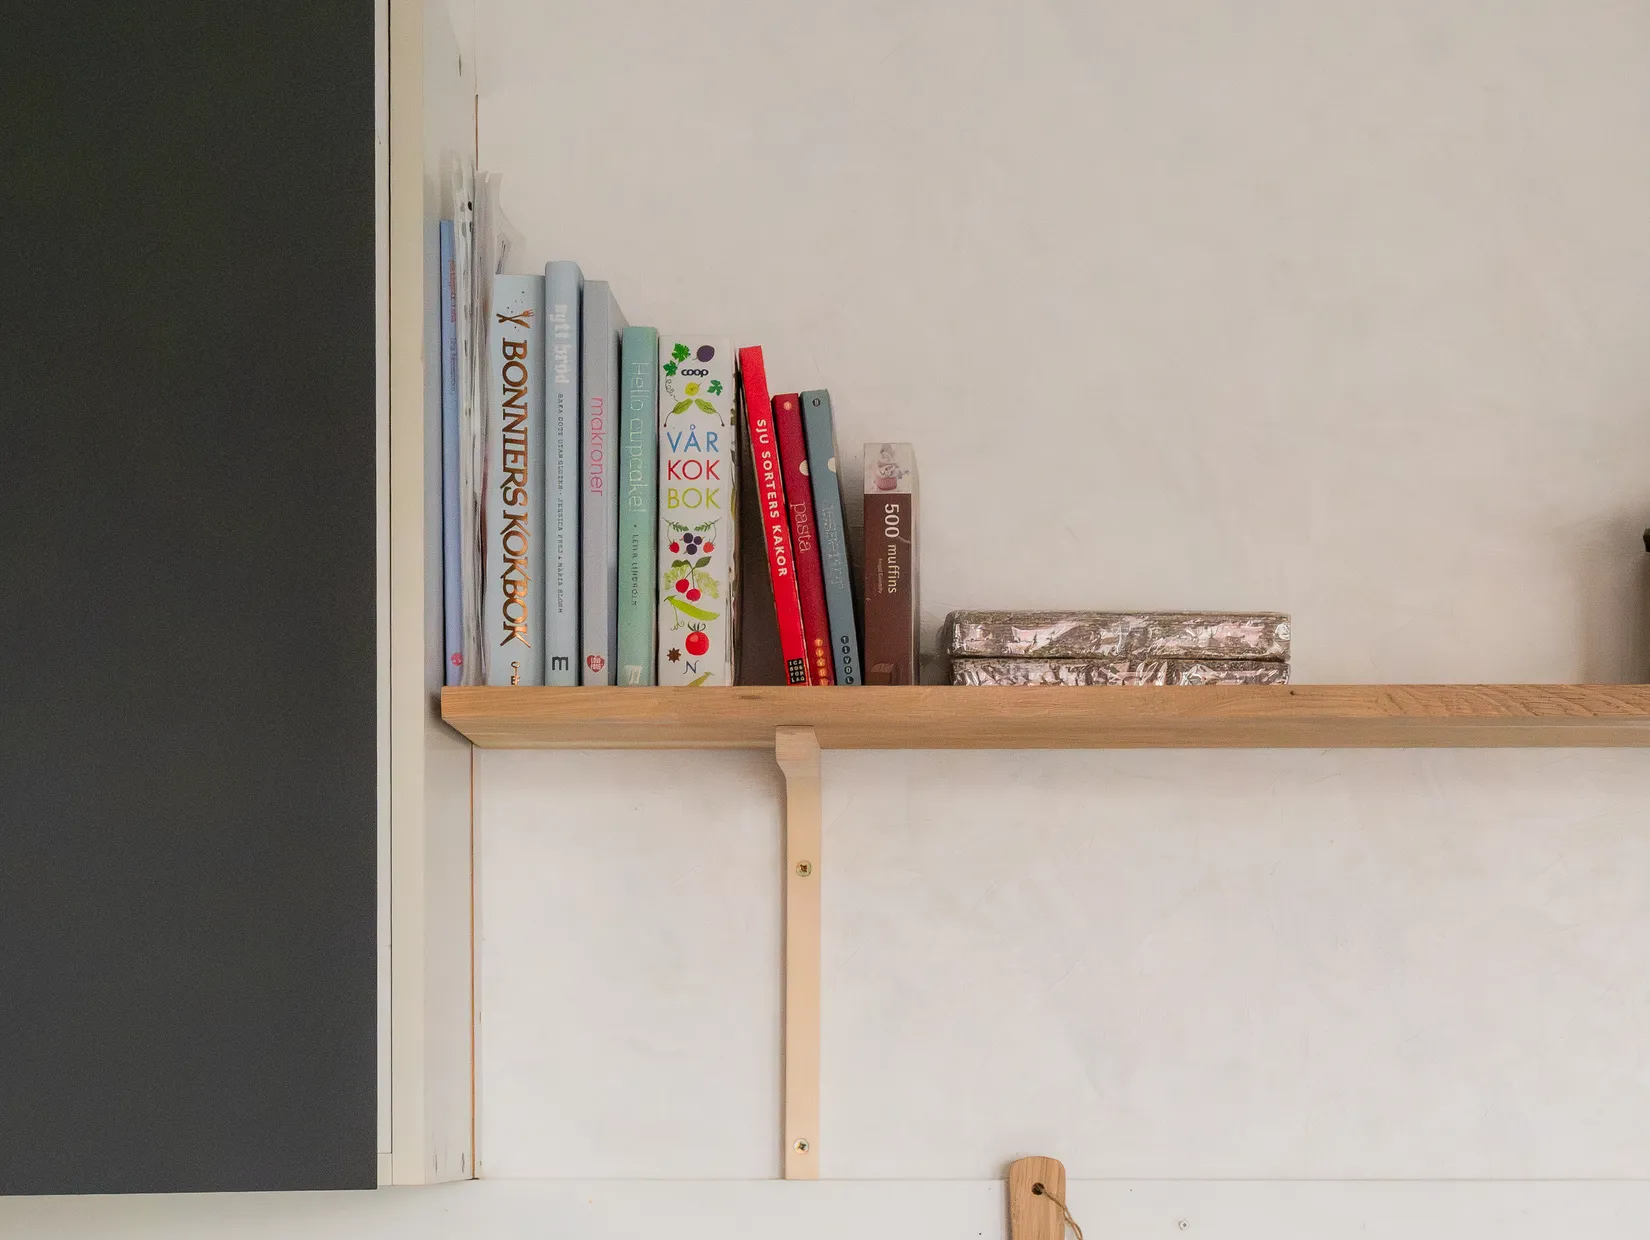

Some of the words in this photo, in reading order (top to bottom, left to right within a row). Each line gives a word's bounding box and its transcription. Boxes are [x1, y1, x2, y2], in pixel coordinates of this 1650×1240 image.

[630, 362, 650, 412] Hello
[681, 368, 709, 378] coop
[500, 337, 528, 507] BONNIERS
[590, 397, 606, 497] makroner
[666, 424, 719, 453] VÅR
[755, 418, 769, 444] SJU
[625, 417, 648, 513] cupcake!
[668, 460, 721, 481] KOK
[761, 451, 780, 519] SORTERS
[667, 488, 721, 509] BOK
[884, 503, 900, 538] 500
[772, 524, 788, 577] KAKOR
[790, 501, 813, 553] pasta
[499, 509, 531, 649] KOKBOK
[887, 544, 900, 594] muffins
